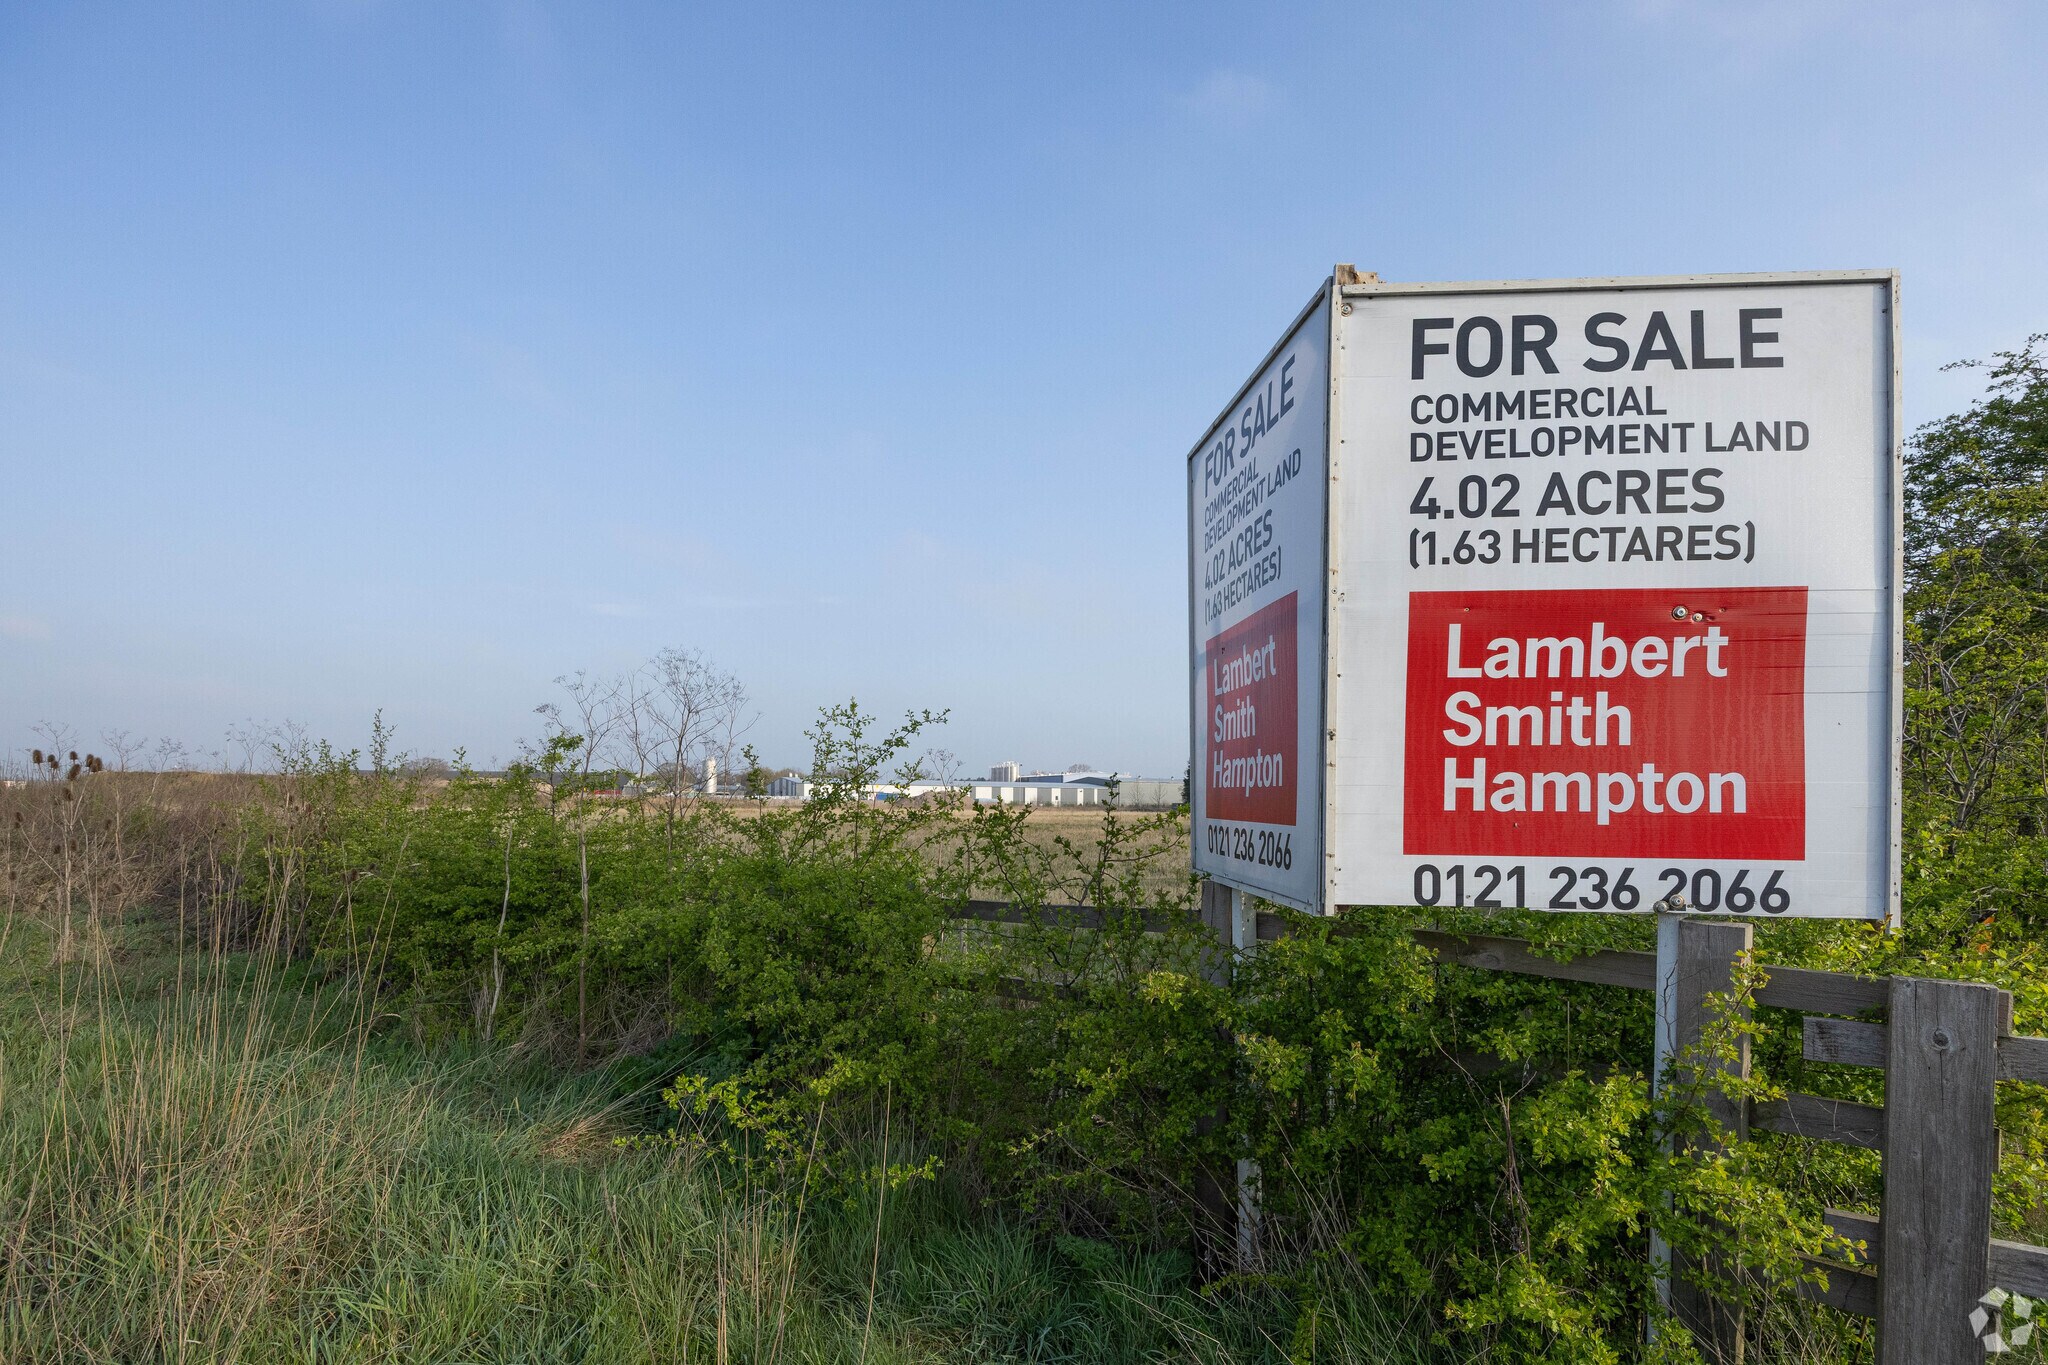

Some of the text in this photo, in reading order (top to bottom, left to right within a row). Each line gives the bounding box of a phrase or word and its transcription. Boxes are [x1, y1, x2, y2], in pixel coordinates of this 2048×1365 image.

[1411, 307, 1784, 380] FOR SALE
[1205, 353, 1296, 498] FOR SALE
[1410, 385, 1667, 424] COMMERCIAL
[1410, 420, 1810, 462] DEVELOPMENT LAND
[1204, 456, 1259, 527] COMMERCIAL
[1204, 448, 1301, 554] DEVELOPMENT LAND
[1409, 467, 1725, 520] 4.02 ACRES
[1204, 508, 1273, 591] 4.02 ACRES
[1409, 520, 1755, 569] (1.63 HECTARES)
[1204, 545, 1282, 625] (1.63 HECTARES)
[1213, 635, 1277, 696] Lambert
[1446, 622, 1729, 678] Lambert
[1213, 695, 1256, 743] Smith
[1443, 690, 1631, 747] Smith
[1213, 748, 1283, 797] Hampton
[1443, 757, 1747, 825] Hampton
[1208, 824, 1292, 870] 0121 236 2066
[1413, 863, 1791, 915] 0121 236 2066
